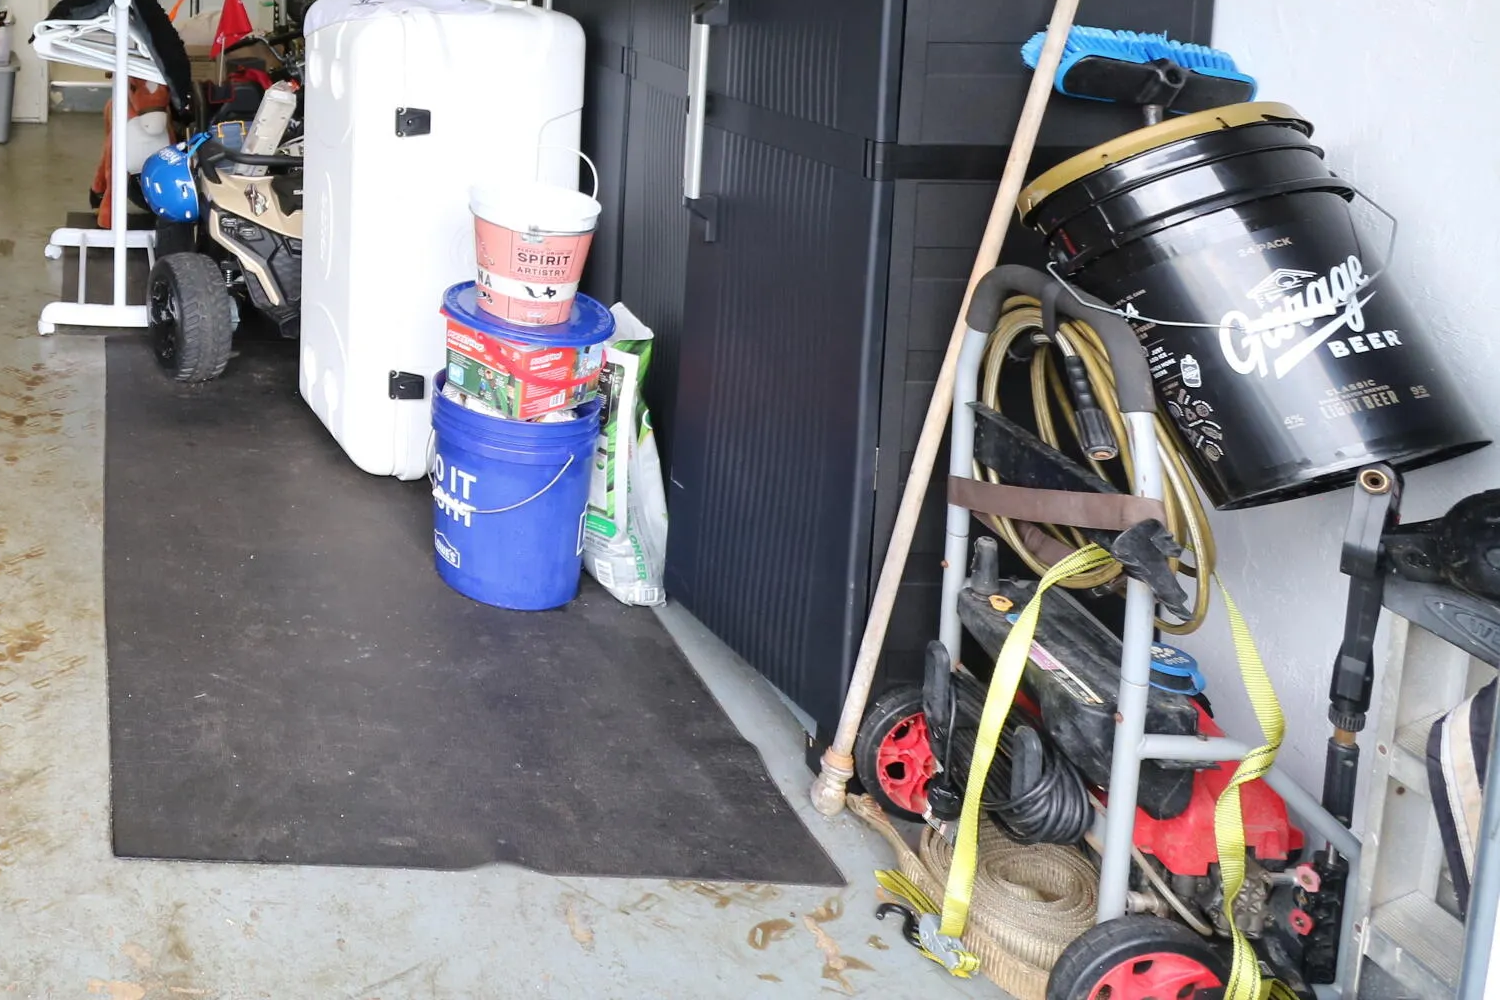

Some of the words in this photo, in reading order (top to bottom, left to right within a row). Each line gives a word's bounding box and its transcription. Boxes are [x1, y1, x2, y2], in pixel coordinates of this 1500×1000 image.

[1257, 236, 1294, 252] PACK
[517, 252, 571, 266] SPIRIT
[516, 266, 567, 277] ARTISTRY
[1219, 254, 1376, 379] Garage
[1327, 330, 1403, 359] BEER
[1325, 379, 1377, 397] CLASSIC
[1362, 390, 1401, 411] BEER
[450, 465, 477, 500] IT
[627, 527, 648, 581] LONGER
